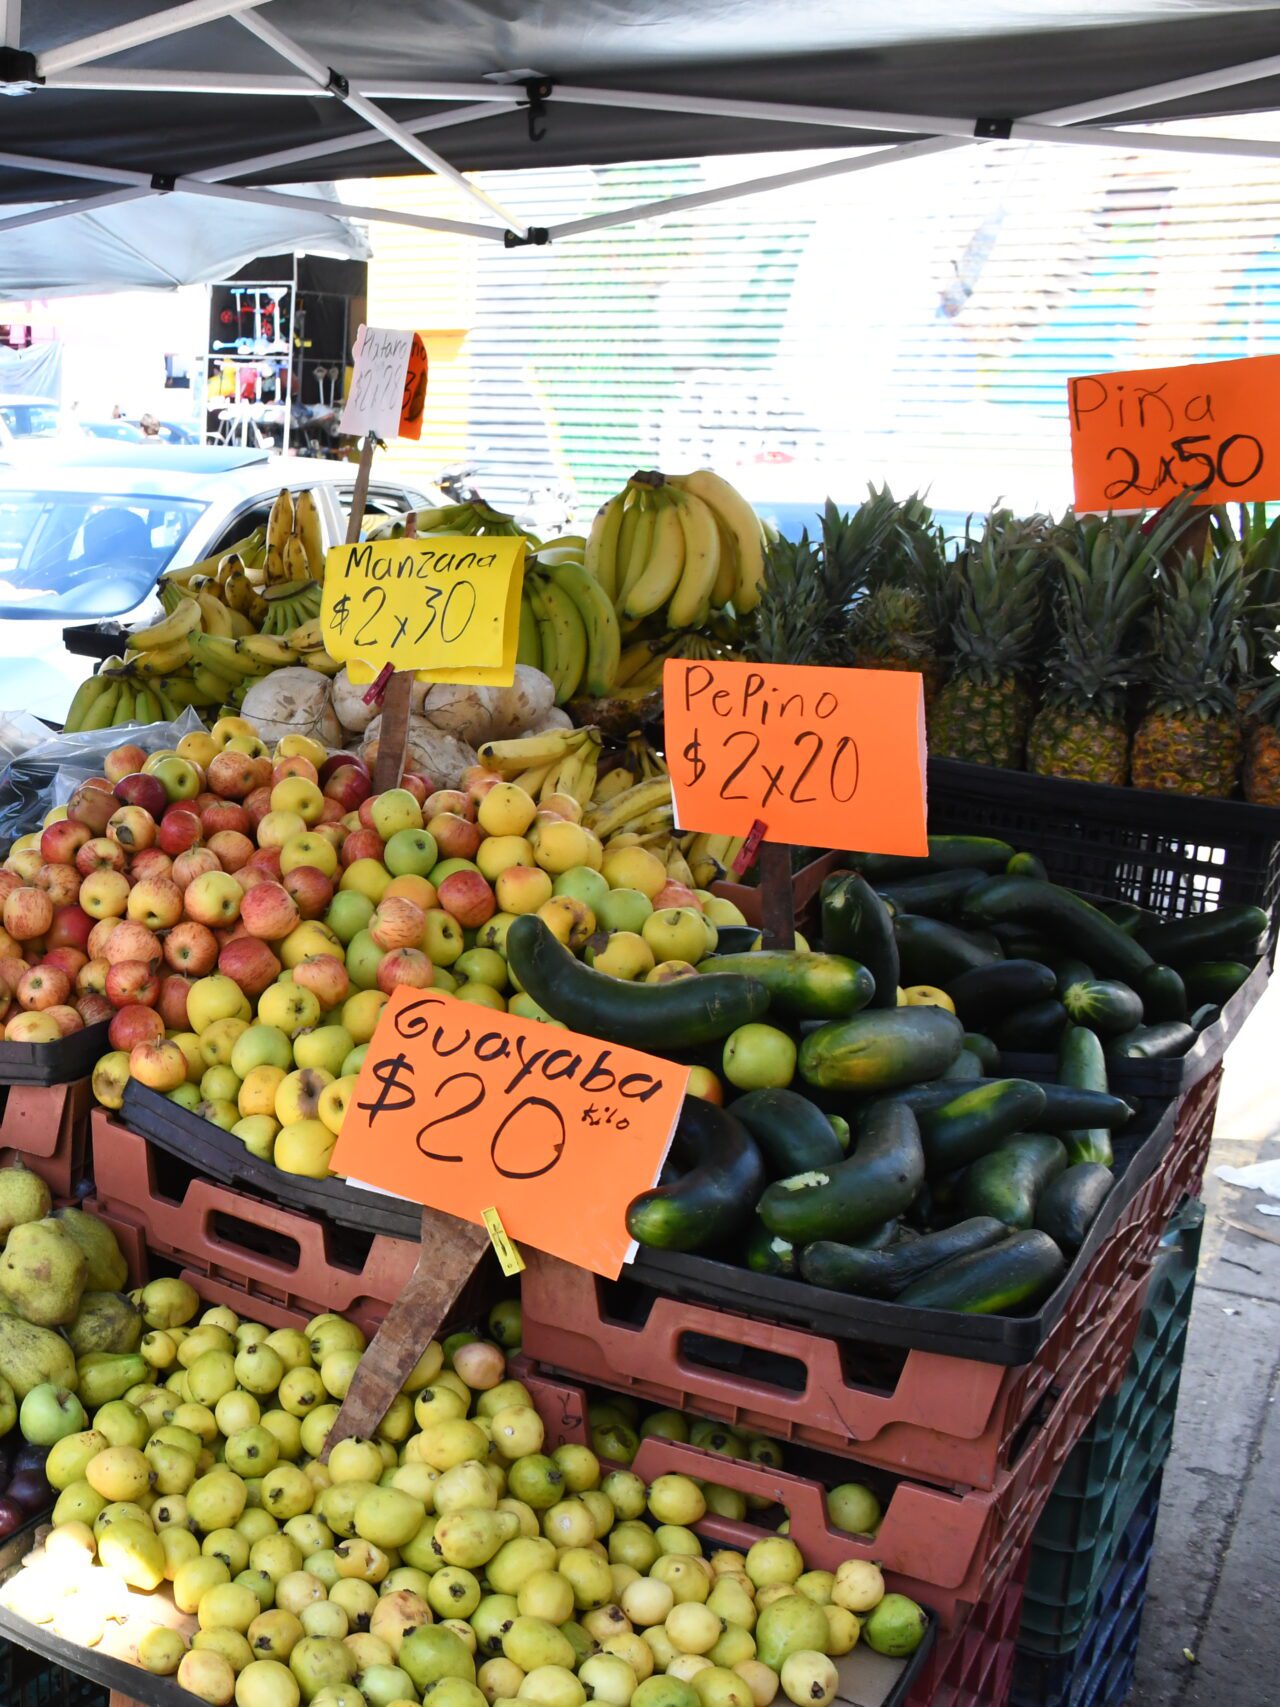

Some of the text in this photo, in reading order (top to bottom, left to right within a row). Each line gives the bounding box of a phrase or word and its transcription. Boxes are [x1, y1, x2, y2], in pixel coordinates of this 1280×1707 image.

[1072, 377, 1215, 432] Piña
[1104, 434, 1264, 500] 2x50
[344, 545, 498, 580] Manzana
[394, 999, 663, 1103] Guayaba
[357, 1052, 566, 1180] $20
